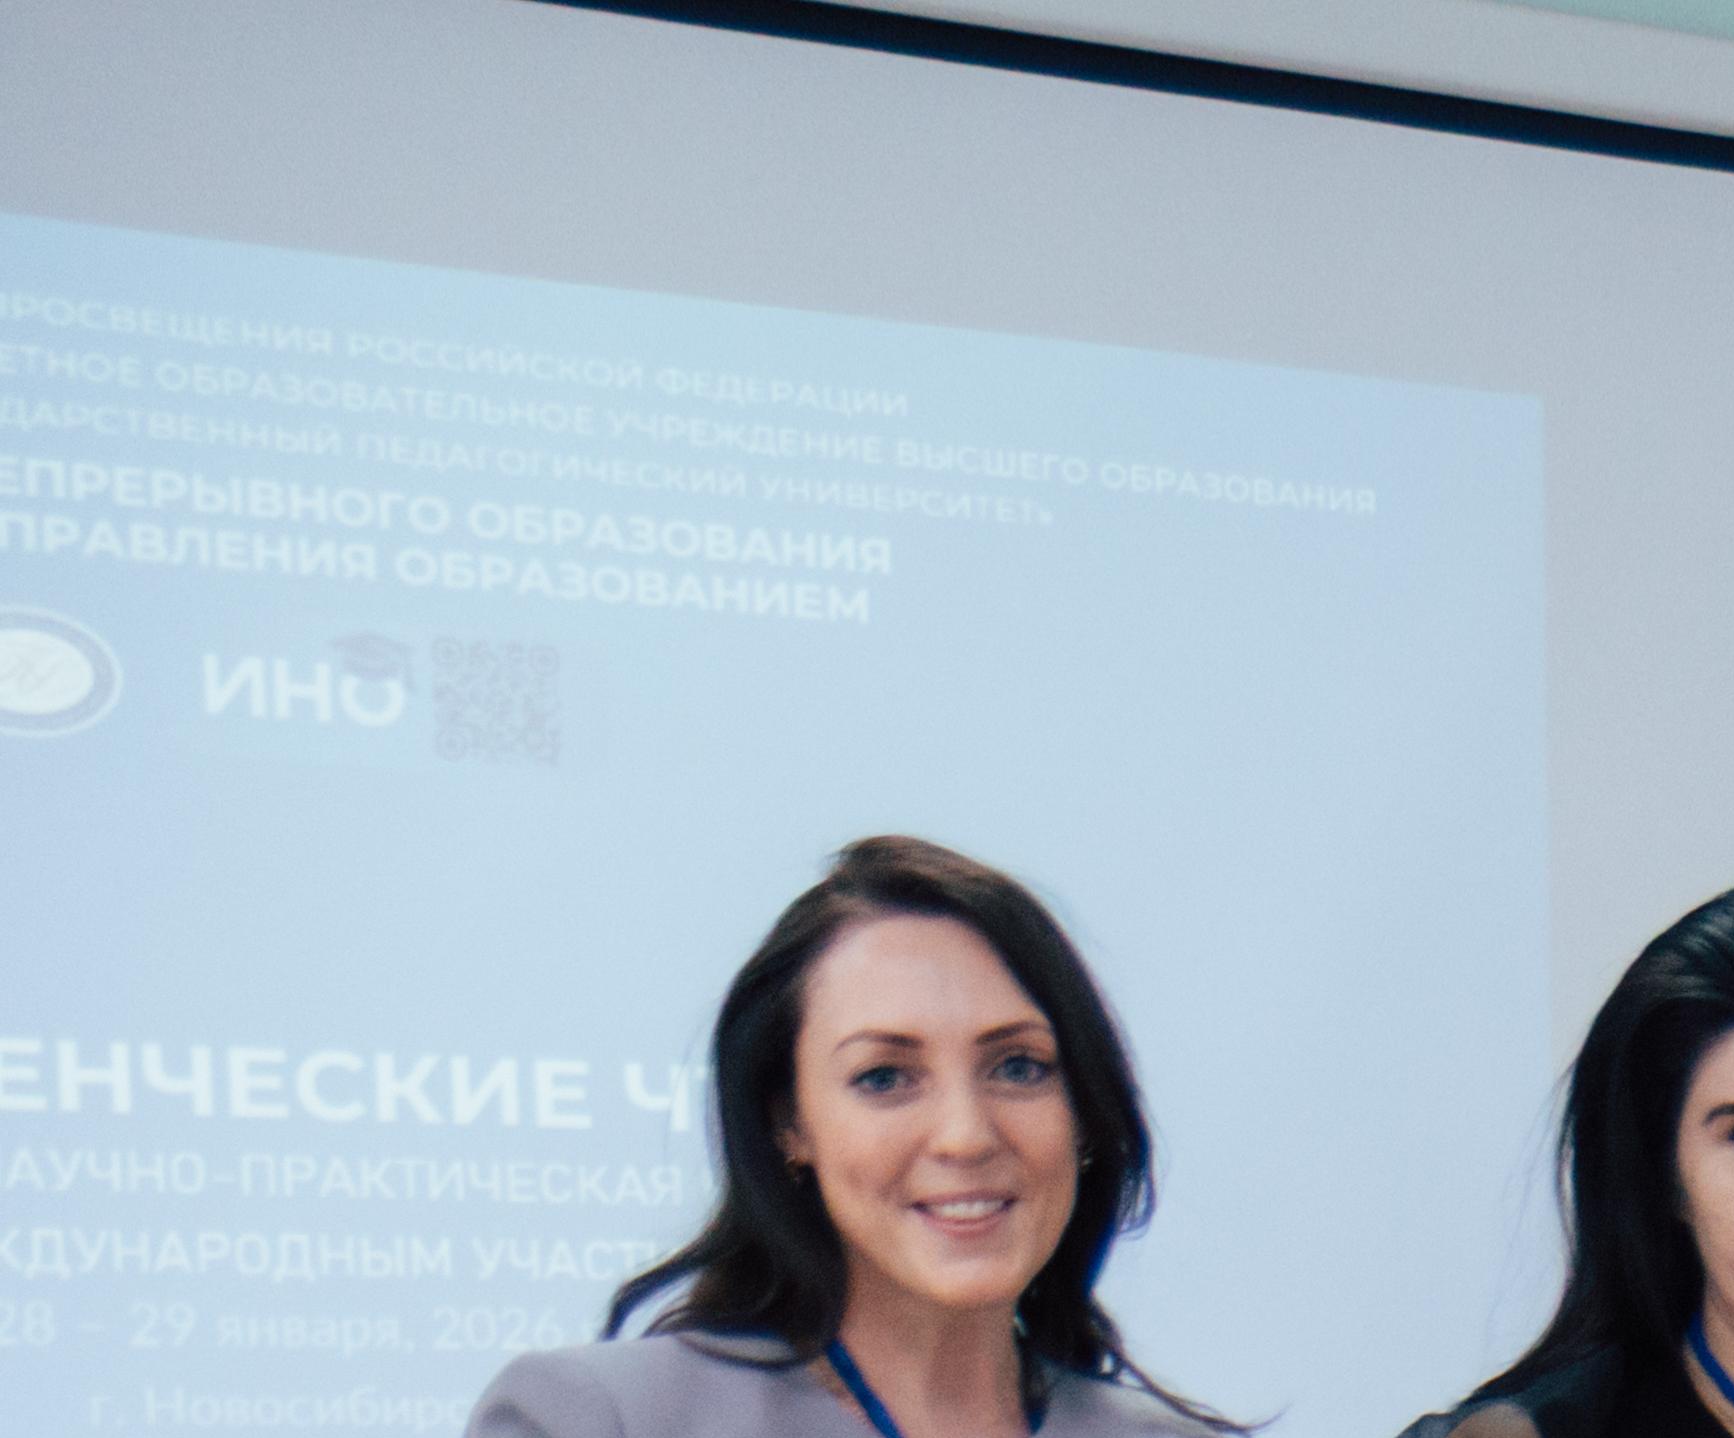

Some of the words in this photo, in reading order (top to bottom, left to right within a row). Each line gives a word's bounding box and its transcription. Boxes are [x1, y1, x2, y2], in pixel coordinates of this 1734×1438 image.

[348, 332, 645, 391] РОССИЙСКОЙ
[654, 365, 909, 418] ФЕДЕРАЦИИ
[153, 359, 598, 437] ОБРАЗОВАТЕЛЬНОЕ
[605, 405, 884, 466] УЧРЕЖДЕНИЕ
[894, 437, 1090, 487] ВЫСШЕГО
[1099, 460, 1378, 515] ОБРАЗОВАНИЯ
[356, 431, 748, 499] ПЕДАГОГИЧЕСКИЙ
[467, 498, 894, 576] ОБРАЗОВАНИЯ
[394, 547, 871, 625] ОБРАЗОВАНИЕМ
[127, 1300, 198, 1349] 29
[431, 1304, 566, 1353] 2026
